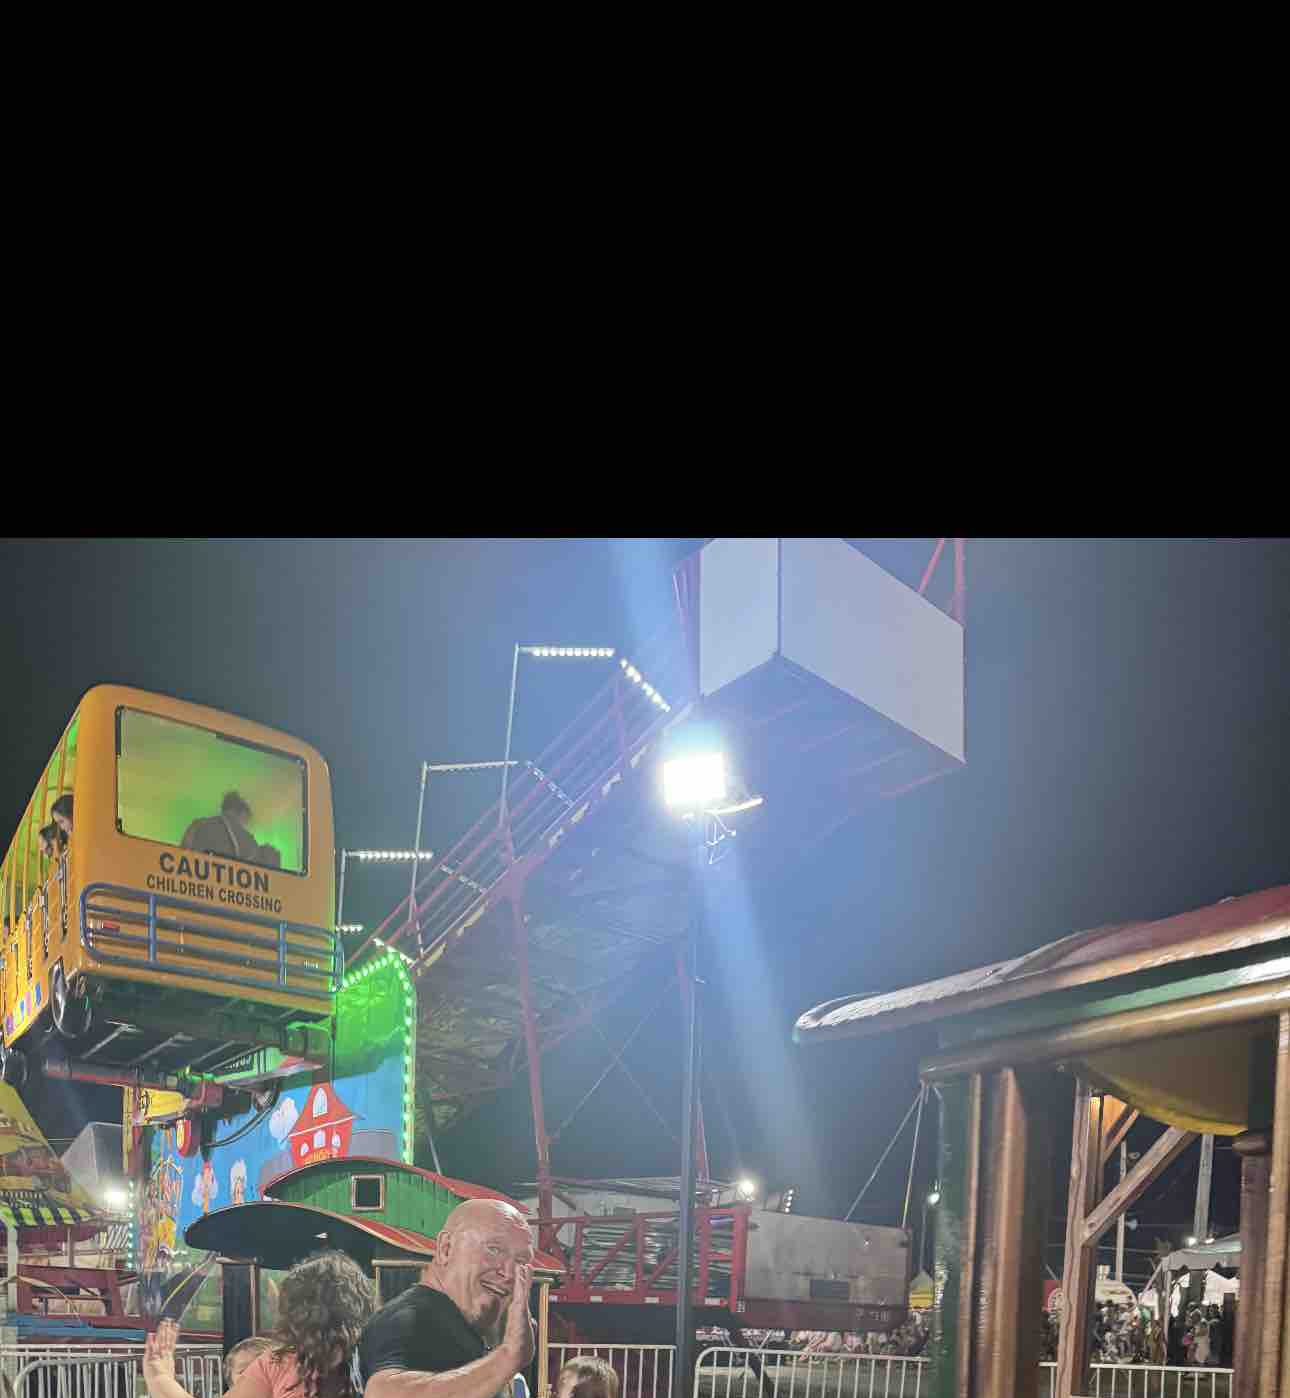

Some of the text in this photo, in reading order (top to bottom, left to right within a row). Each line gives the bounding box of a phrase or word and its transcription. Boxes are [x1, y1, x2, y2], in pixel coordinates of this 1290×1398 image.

[160, 852, 269, 892] CAUTION
[146, 873, 282, 913] CHILDREN CROSSING
